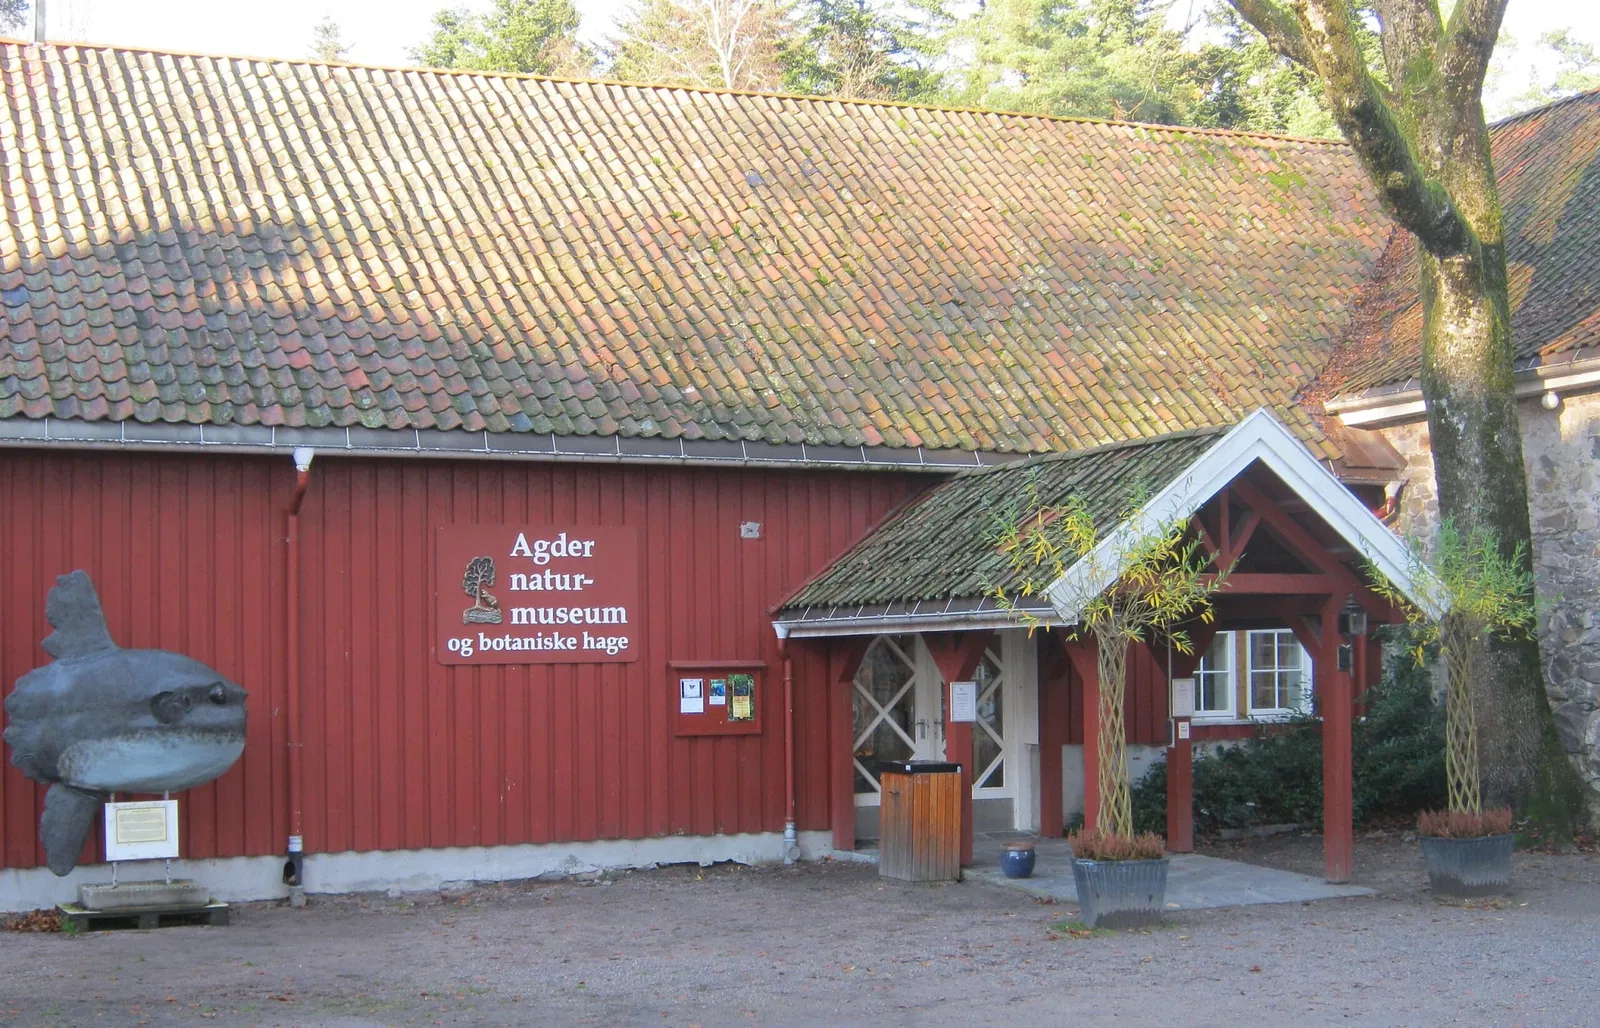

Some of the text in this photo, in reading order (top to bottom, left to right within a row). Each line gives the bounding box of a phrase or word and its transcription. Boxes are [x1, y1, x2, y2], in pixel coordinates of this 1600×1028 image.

[509, 532, 595, 564] Agder
[509, 568, 594, 591] natur-
[510, 606, 628, 625] museum
[447, 630, 629, 657] og botaniske hage
